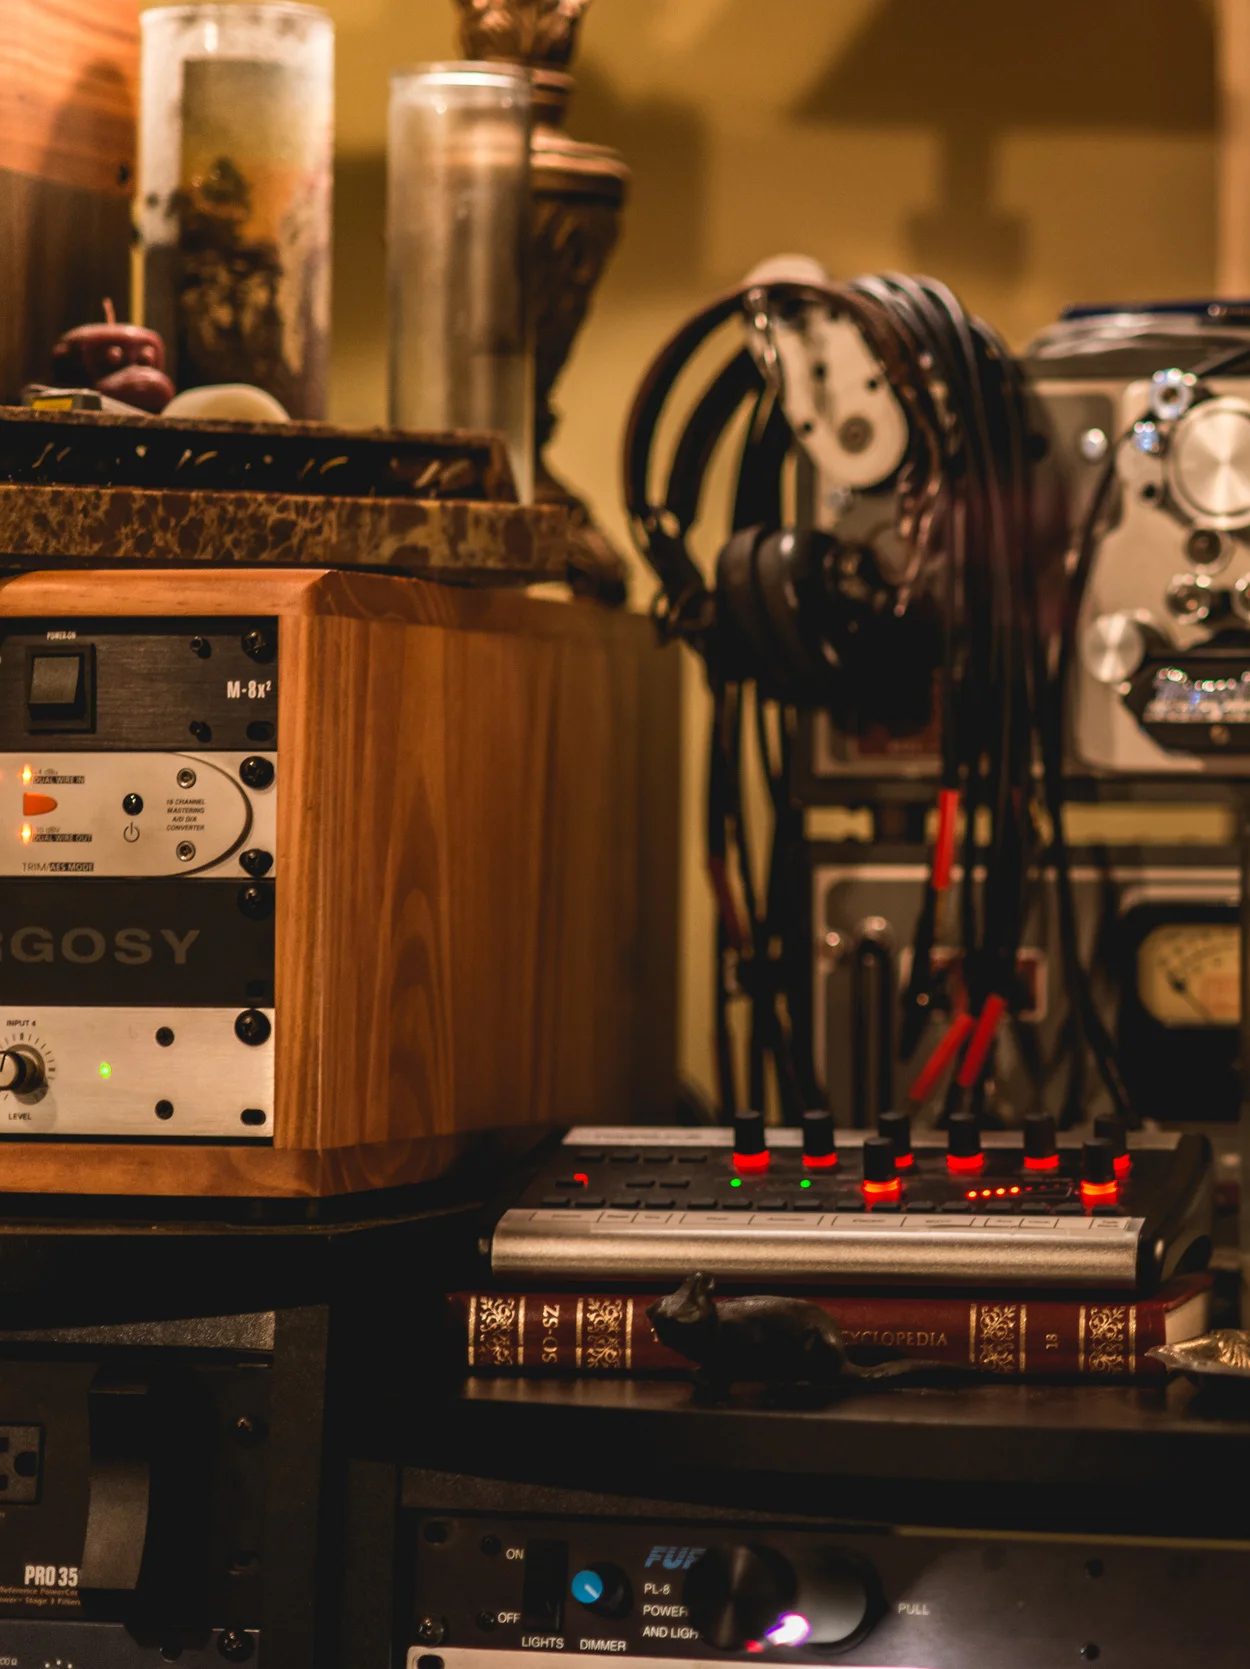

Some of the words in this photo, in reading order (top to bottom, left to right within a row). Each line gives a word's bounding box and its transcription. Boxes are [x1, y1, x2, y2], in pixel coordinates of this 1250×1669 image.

[0, 927, 200, 964] GOSY
[8, 1112, 31, 1120] LEVEL
[506, 1549, 524, 1560] ON
[24, 1565, 56, 1586] PRO
[58, 1566, 78, 1587] 35
[644, 1583, 670, 1595] PL-8
[897, 1602, 930, 1616] PULL
[498, 1612, 521, 1624] OFF
[642, 1627, 668, 1639] AND
[521, 1636, 565, 1650] LIGHTS
[579, 1639, 627, 1651] DIMMER
